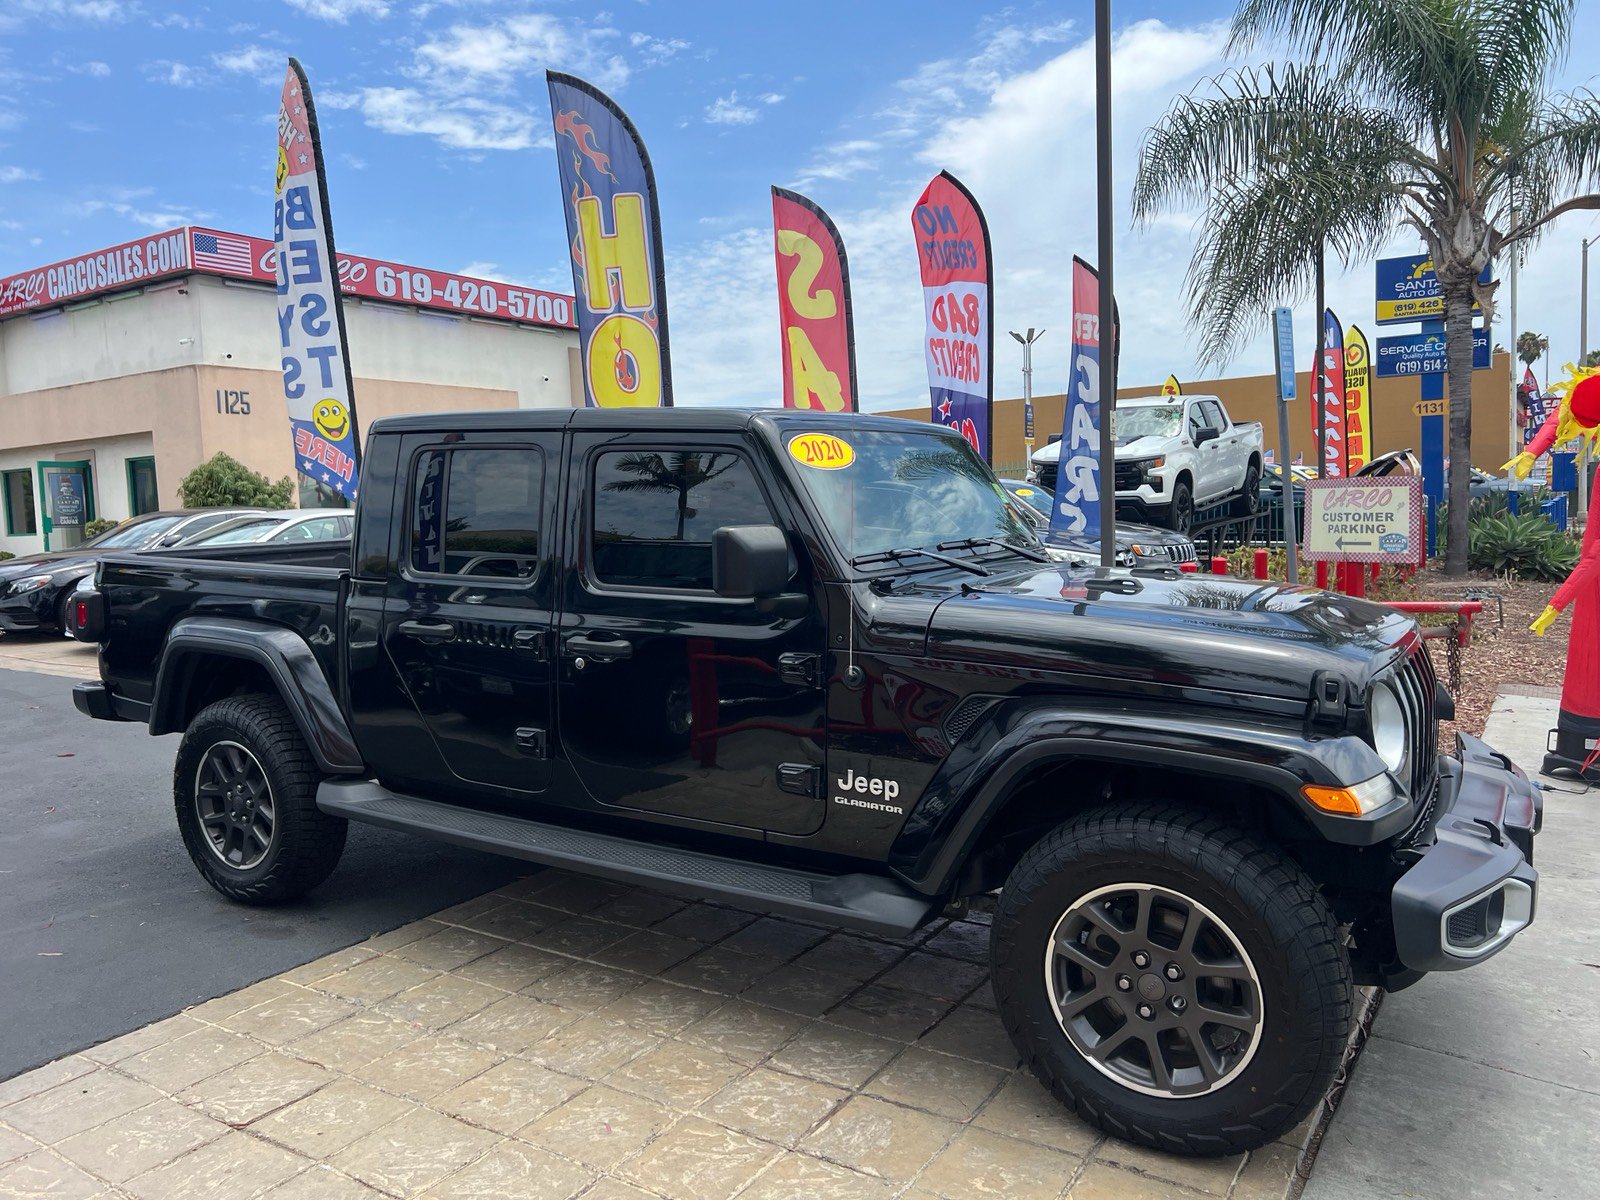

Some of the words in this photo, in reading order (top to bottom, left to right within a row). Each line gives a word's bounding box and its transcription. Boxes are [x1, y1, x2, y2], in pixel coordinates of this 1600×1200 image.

[47, 232, 187, 301] CARCOSALES.COM
[1395, 278, 1442, 292] SANT
[375, 266, 569, 325] 619-420-5700
[1398, 288, 1425, 299] AUTO
[1394, 302, 1417, 312] (619)
[1419, 300, 1439, 309] 426
[1380, 343, 1432, 356] SERVICE
[1402, 351, 1424, 359] Quality
[1395, 361, 1421, 374] (619)
[1423, 359, 1441, 371] 614
[216, 389, 251, 415] 1125
[1416, 402, 1444, 414] 1131
[801, 440, 843, 462] 2020
[1322, 488, 1393, 511] CARCO
[1322, 512, 1394, 522] CUSTOMER
[1327, 524, 1387, 534] PARKING
[837, 769, 900, 801] Jeep
[834, 796, 903, 815] GLADIATOR
